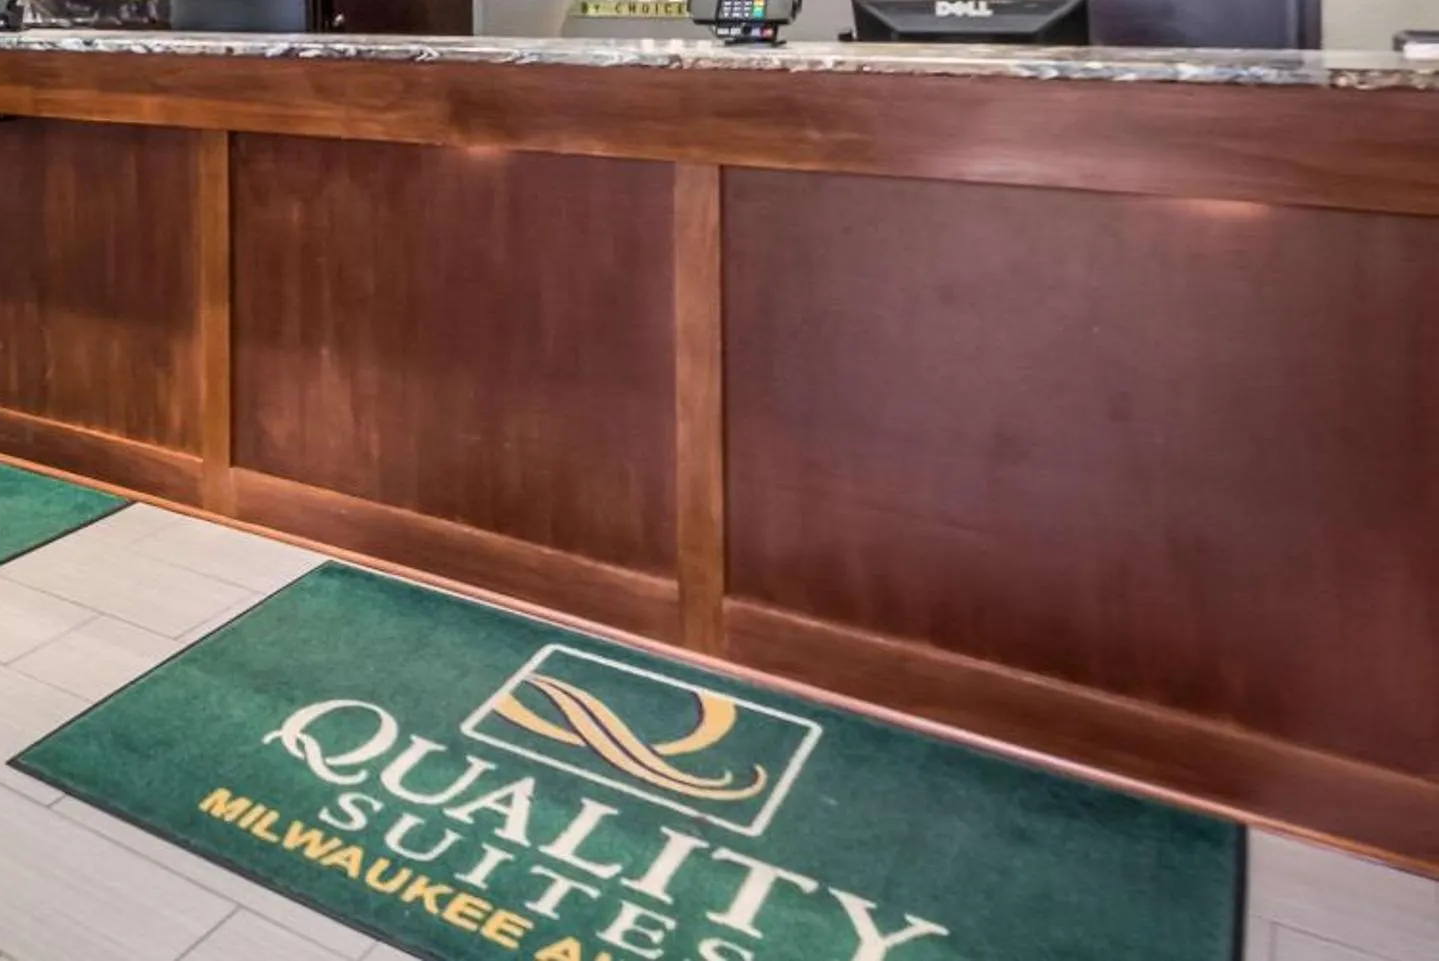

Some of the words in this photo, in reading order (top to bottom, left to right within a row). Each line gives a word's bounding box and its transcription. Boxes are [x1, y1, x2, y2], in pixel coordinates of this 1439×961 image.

[935, 0, 993, 17] DELL
[198, 787, 534, 949] MILWAUKEE
[262, 698, 950, 961] QUALITY
